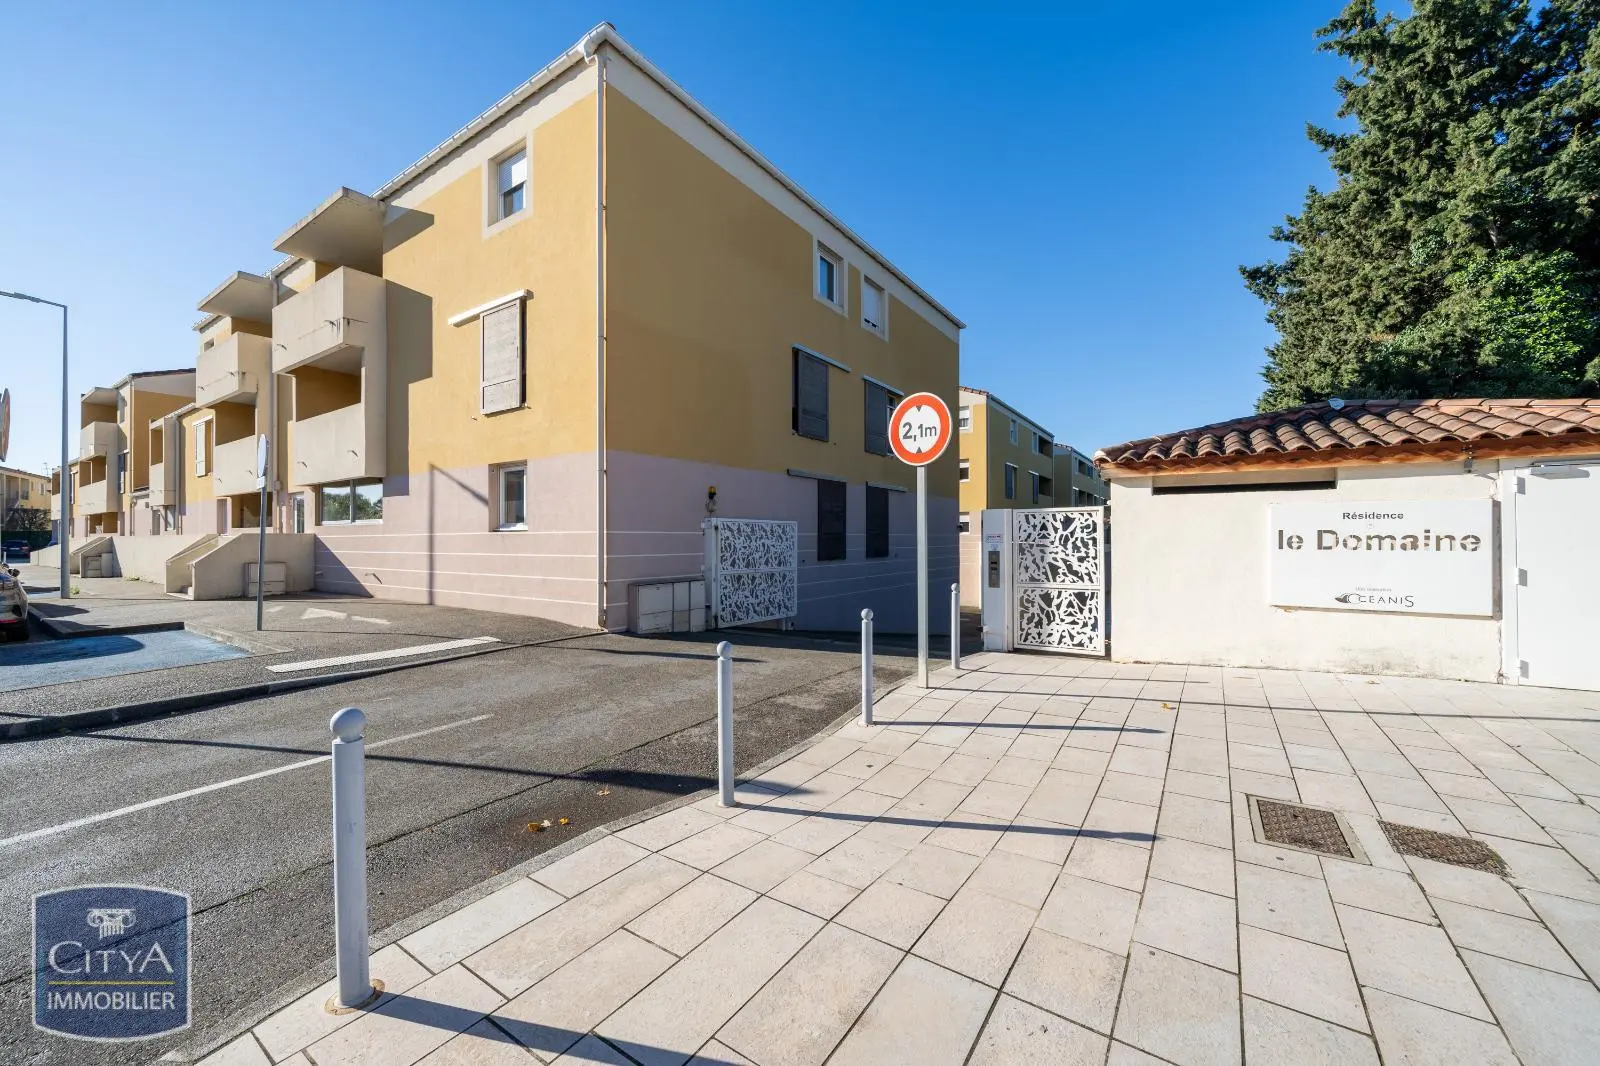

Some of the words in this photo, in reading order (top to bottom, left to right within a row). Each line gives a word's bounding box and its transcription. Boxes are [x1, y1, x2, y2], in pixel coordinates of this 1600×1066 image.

[902, 422, 937, 442] 2,1m
[1342, 511, 1404, 521] Résidence
[1278, 529, 1304, 550] le
[1317, 529, 1482, 552] Domaine
